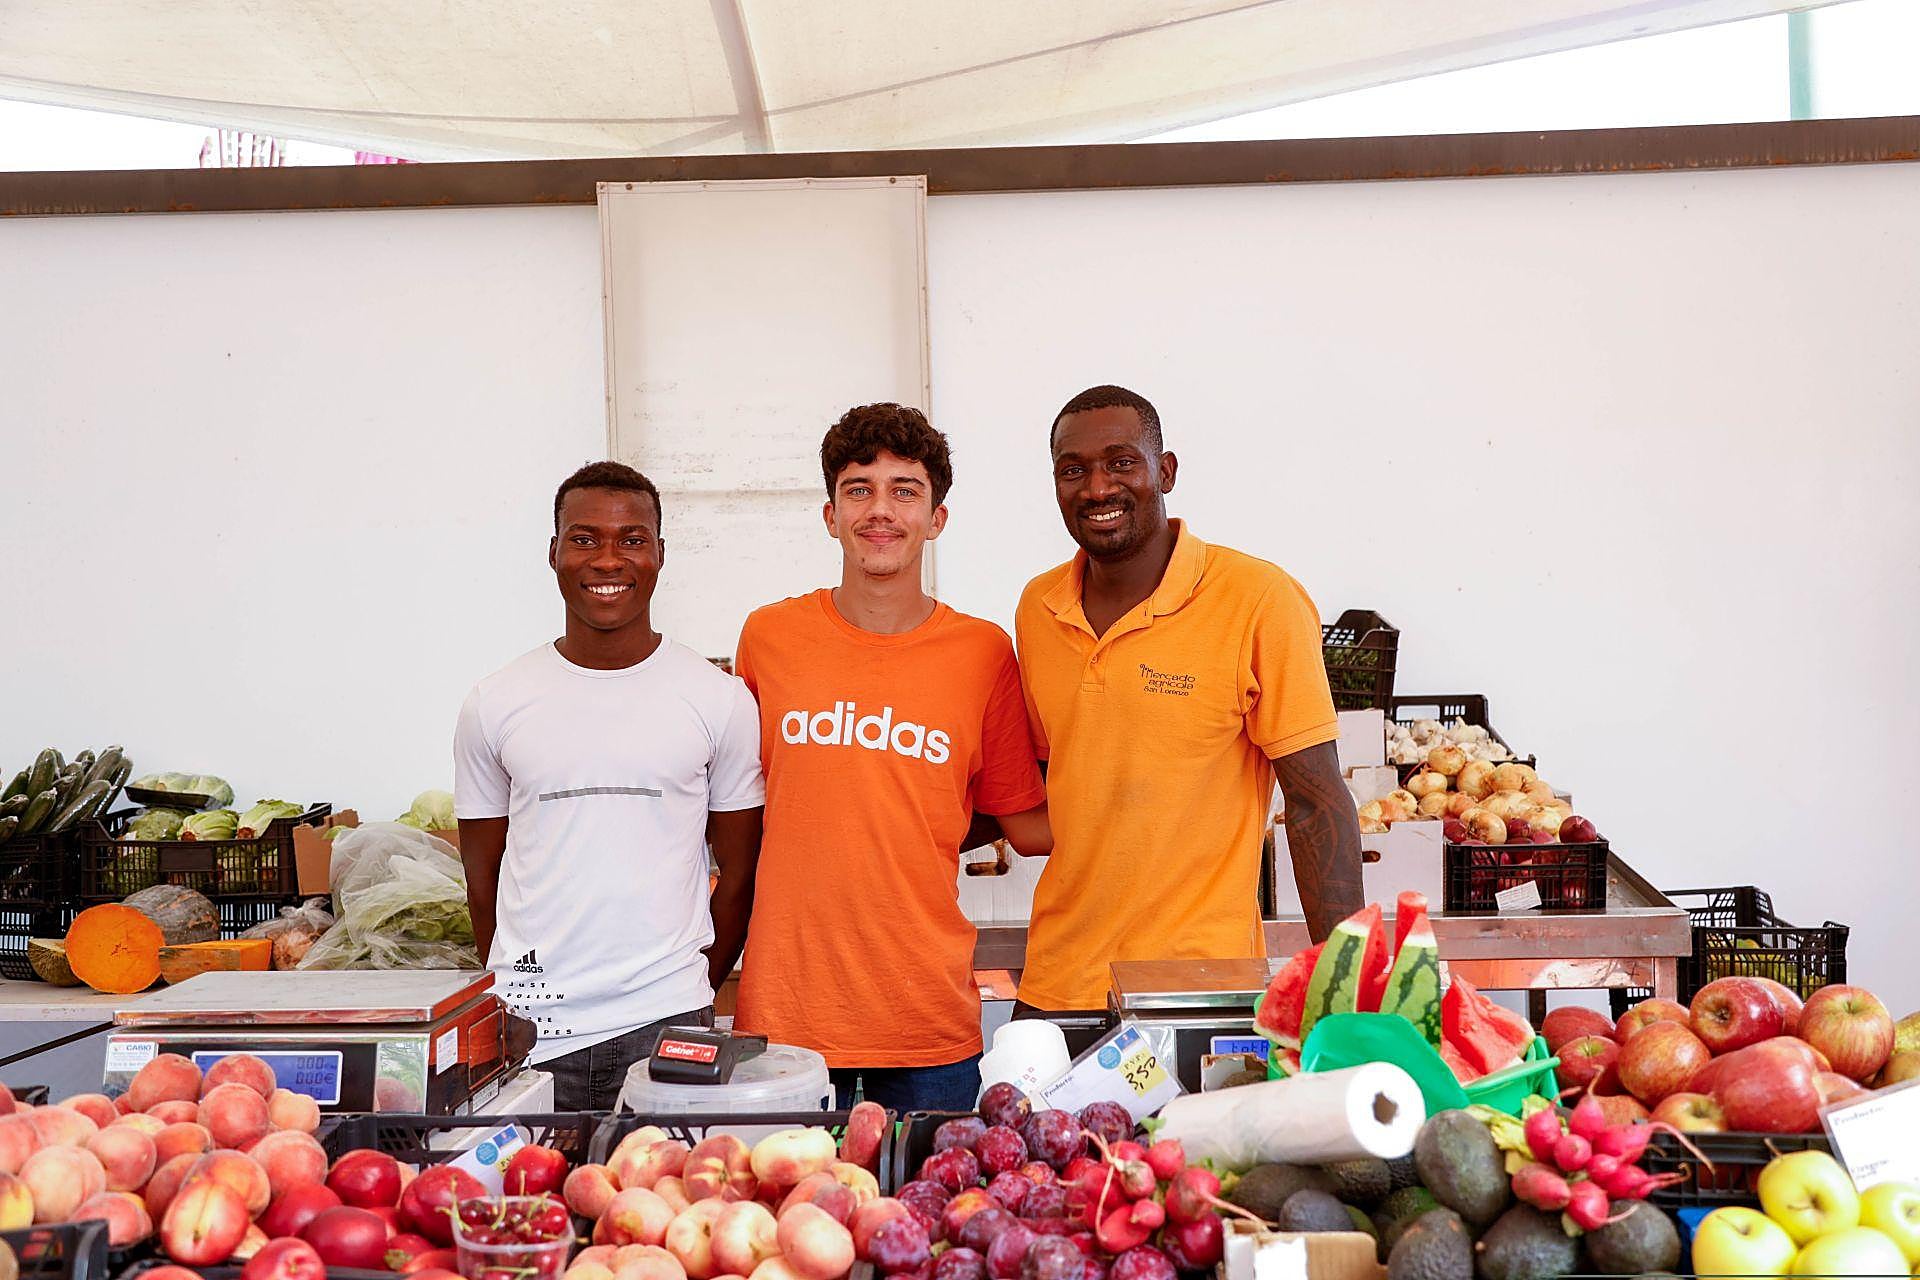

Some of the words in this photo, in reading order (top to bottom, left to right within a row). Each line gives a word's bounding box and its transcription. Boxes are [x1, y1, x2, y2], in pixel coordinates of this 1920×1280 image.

[1140, 664, 1196, 682] Mercado
[1160, 687, 1189, 696] Lorenzo
[781, 701, 950, 764] adidas
[514, 964, 544, 974] adidas
[1126, 1056, 1156, 1090] 3,50
